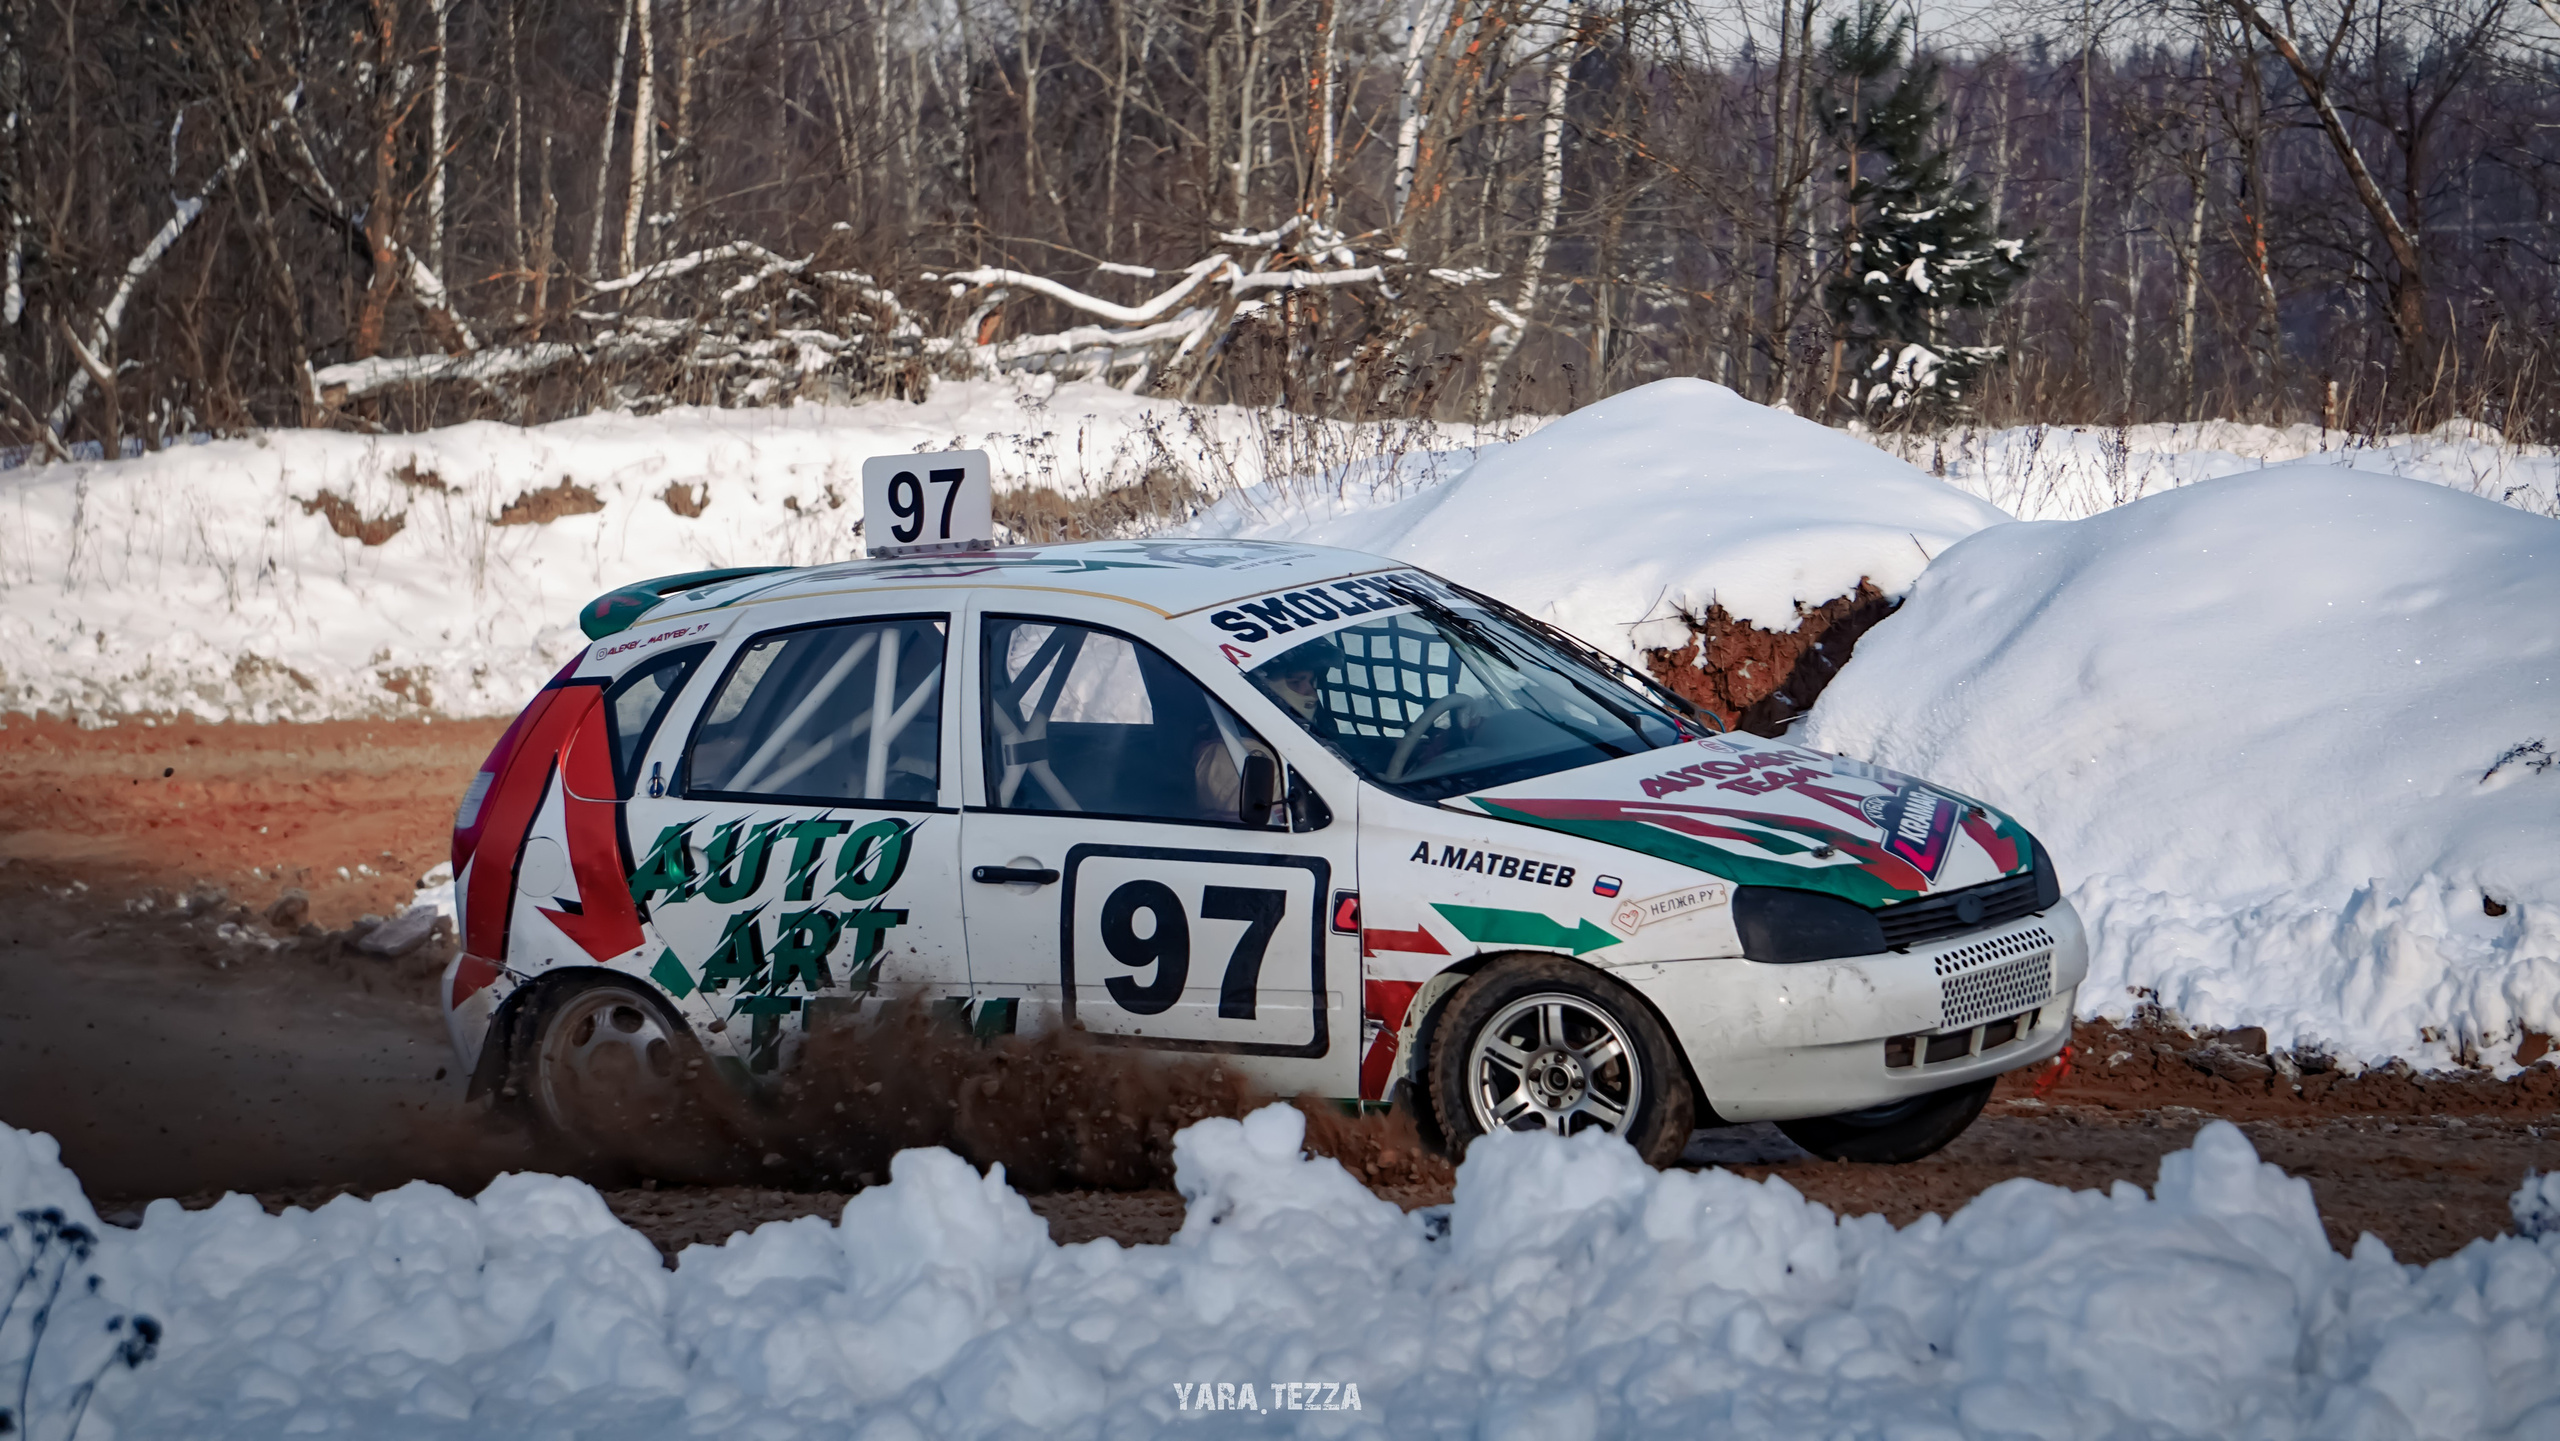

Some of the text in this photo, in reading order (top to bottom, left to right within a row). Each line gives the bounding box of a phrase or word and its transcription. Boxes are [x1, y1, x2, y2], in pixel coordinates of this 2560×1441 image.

[887, 467, 966, 544] 97
[1715, 765, 1834, 796] TEAM
[627, 808, 930, 911] AUTO
[1410, 840, 1576, 888] А.МАТВЕЕВ
[1650, 889, 1714, 916] НЕЛЖА.РУ
[699, 899, 910, 1000] ART
[1100, 879, 1288, 1021] 97
